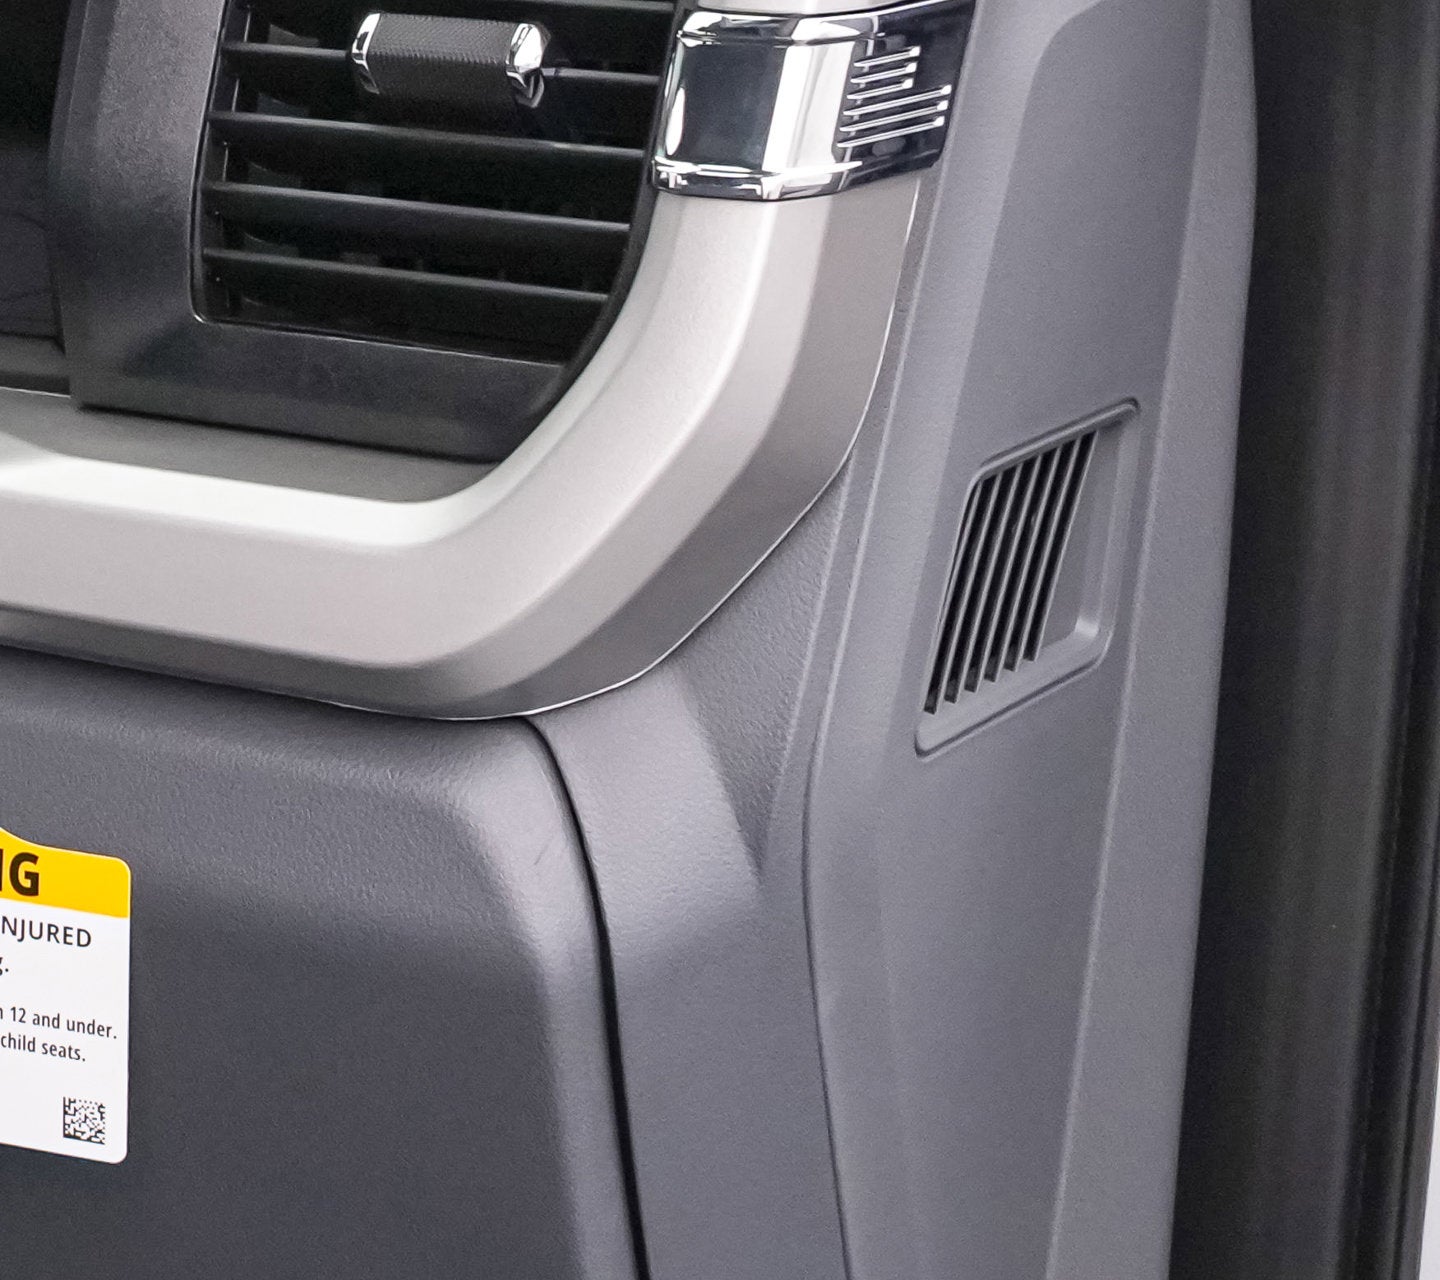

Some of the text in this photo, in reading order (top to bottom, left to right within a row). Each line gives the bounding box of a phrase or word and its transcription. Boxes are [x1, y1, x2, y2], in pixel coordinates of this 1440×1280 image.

[10, 1006, 26, 1023] 12
[32, 1013, 60, 1029] and
[67, 1019, 117, 1039] under.
[1, 1032, 36, 1052] child
[42, 1043, 85, 1062] seats.
